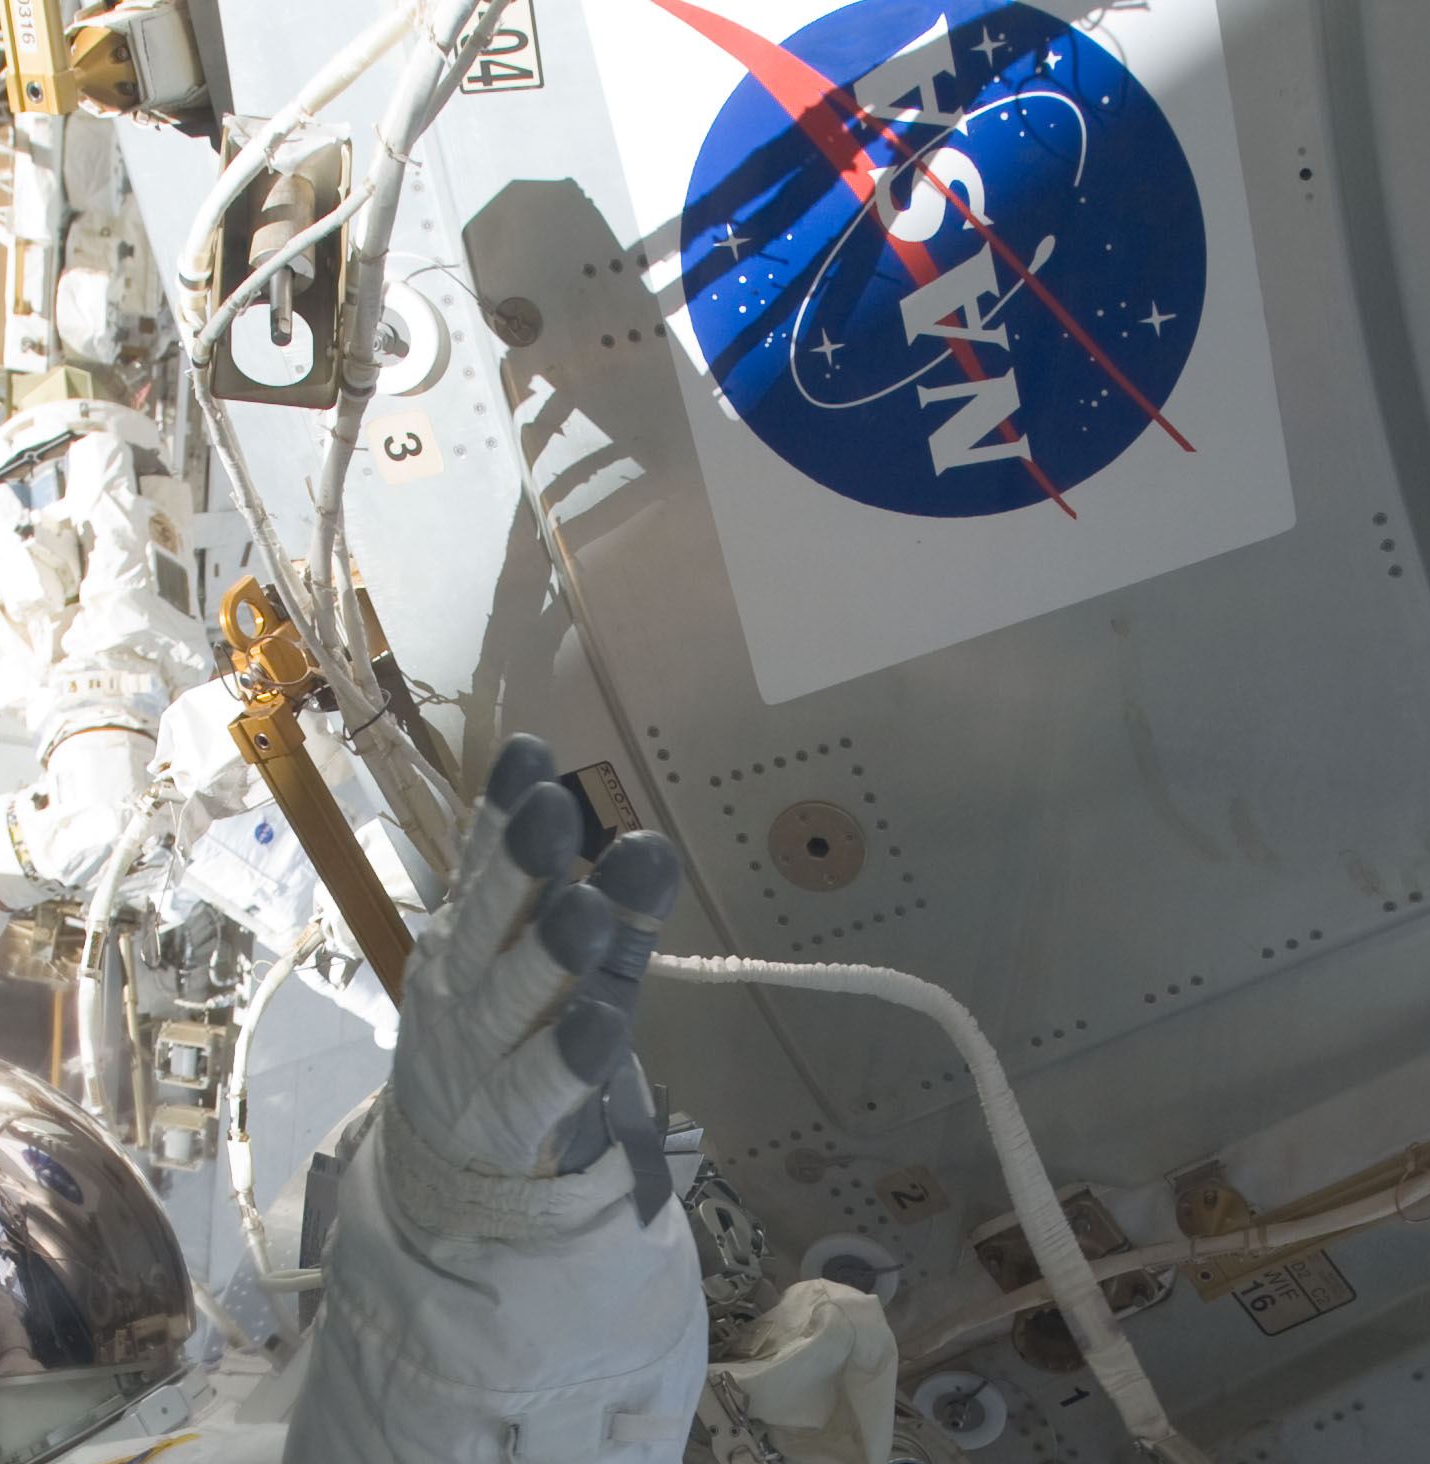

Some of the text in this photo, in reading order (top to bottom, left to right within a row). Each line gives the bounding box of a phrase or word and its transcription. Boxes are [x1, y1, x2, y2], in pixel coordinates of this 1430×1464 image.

[852, 12, 1034, 477] NASA
[383, 433, 424, 464] 3
[892, 1184, 926, 1209] 2
[1241, 1280, 1276, 1312] 16
[1059, 1386, 1090, 1408] 1
